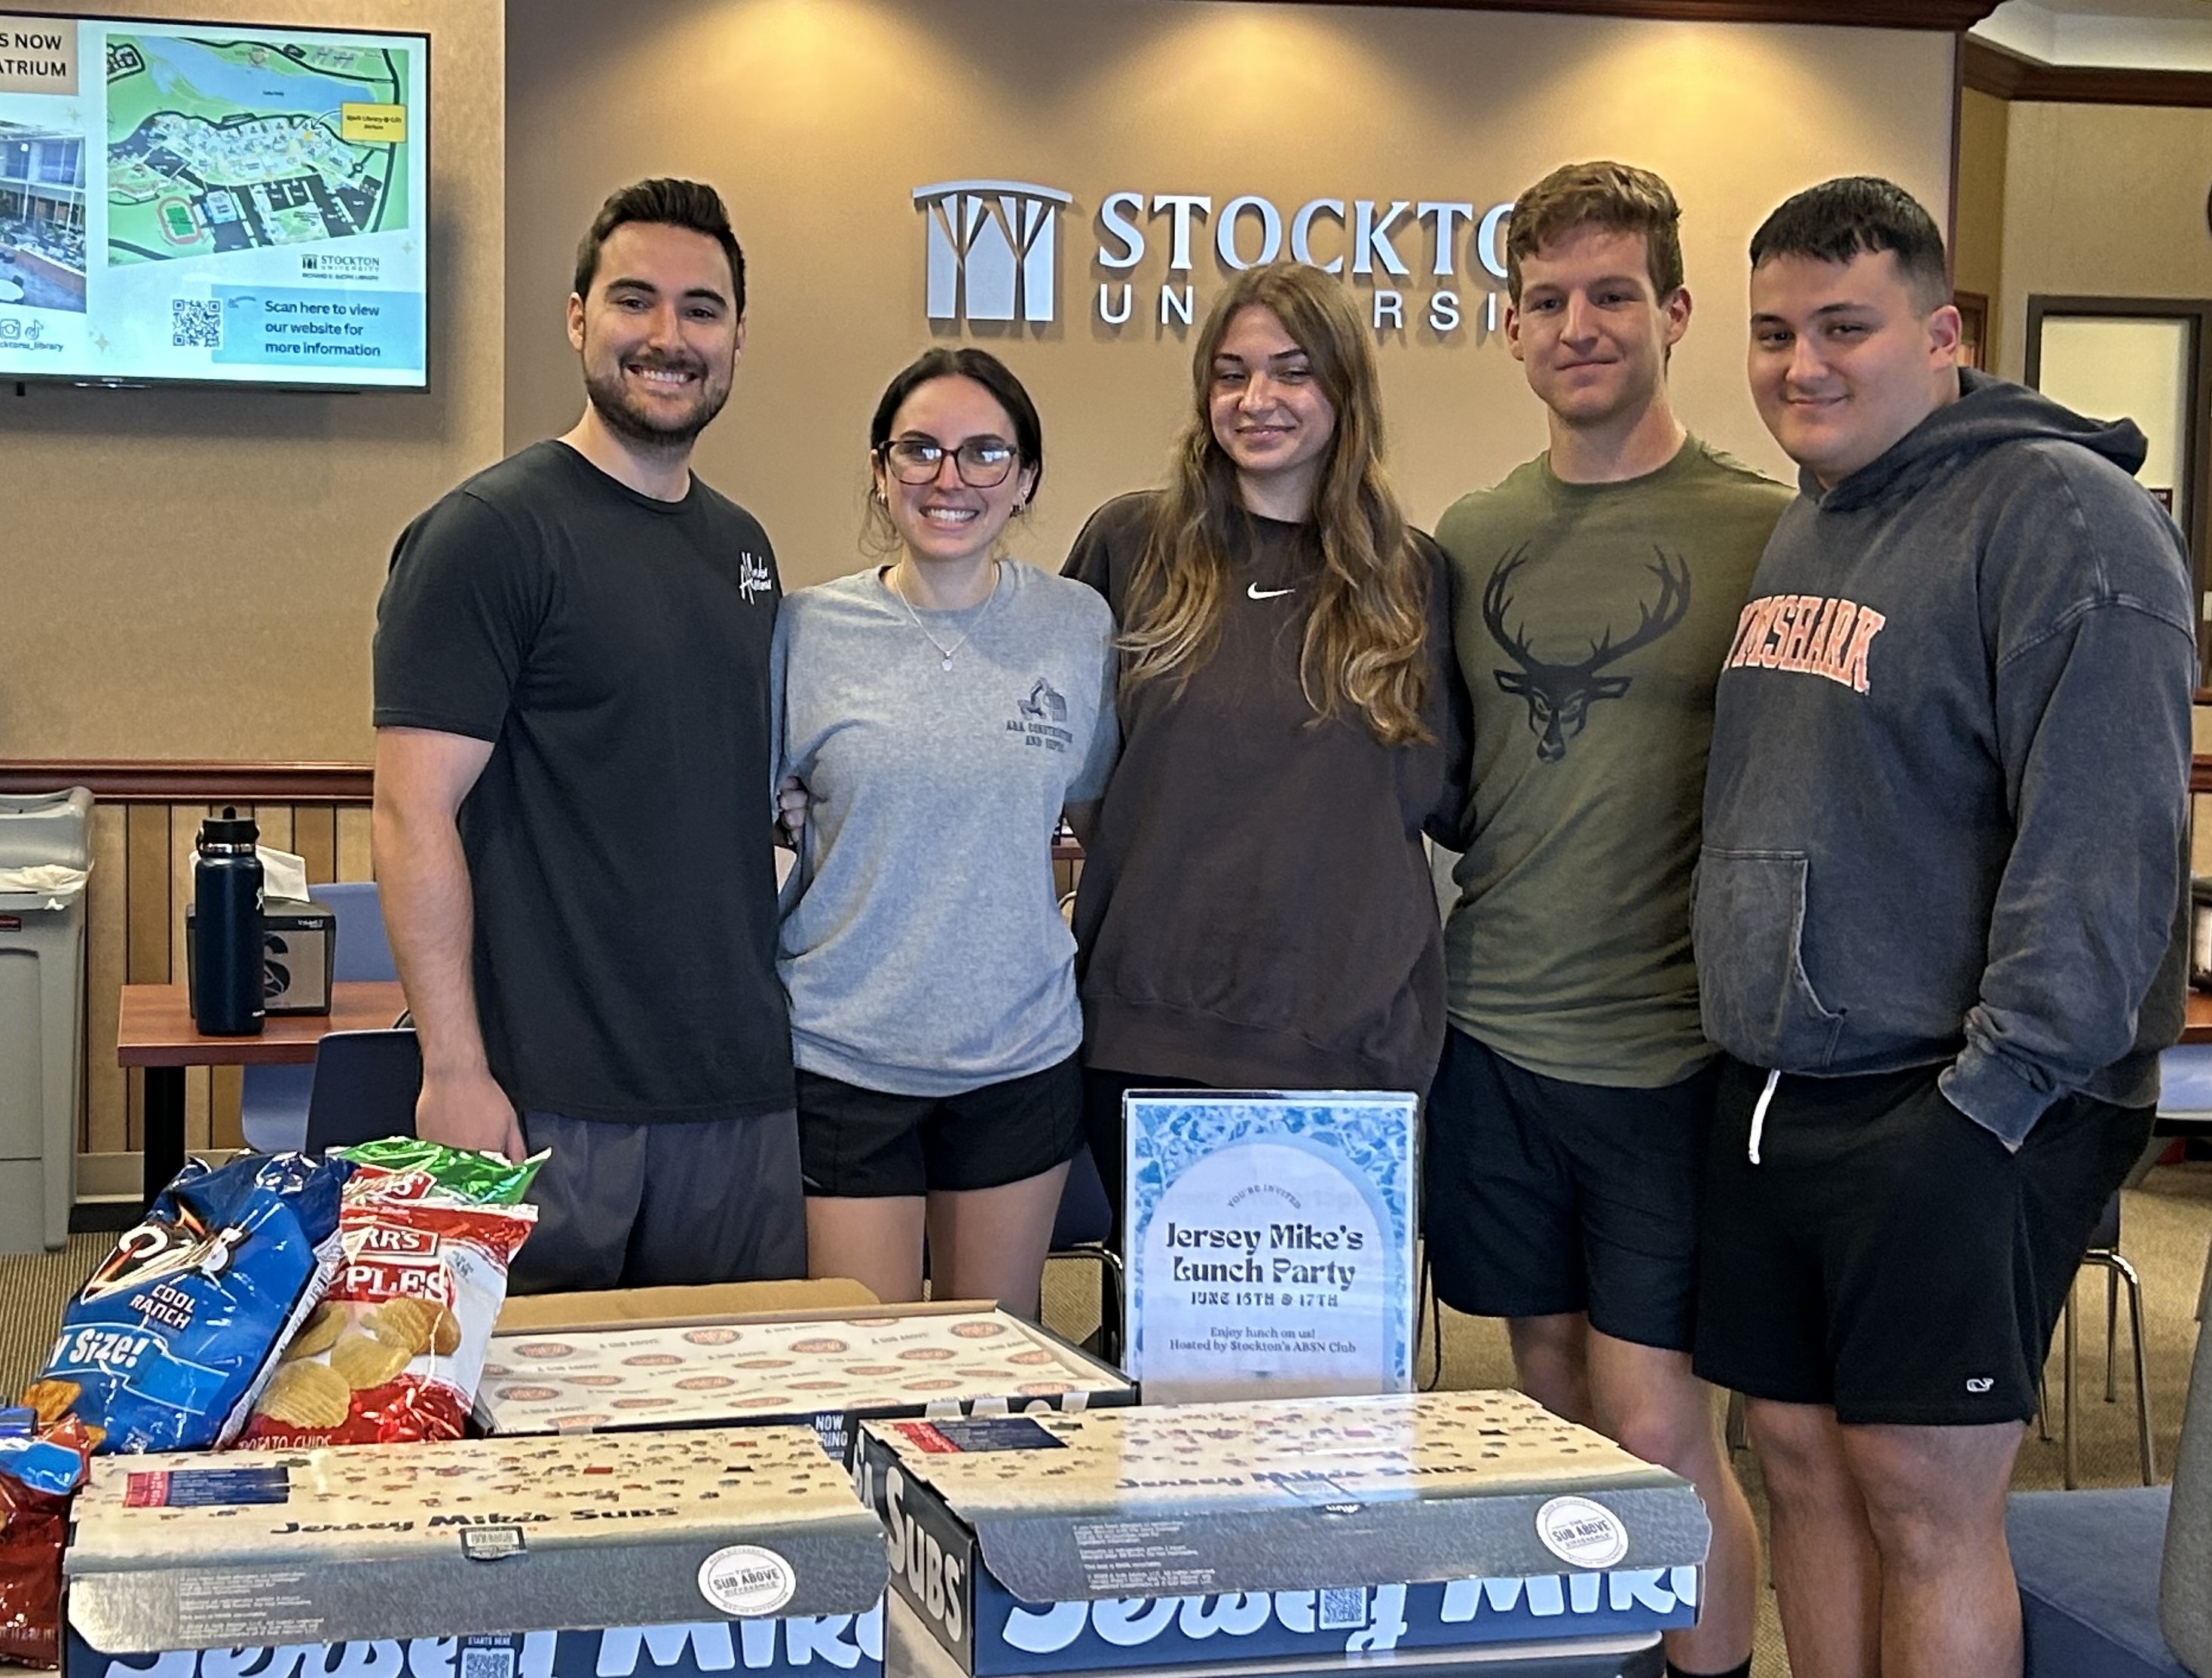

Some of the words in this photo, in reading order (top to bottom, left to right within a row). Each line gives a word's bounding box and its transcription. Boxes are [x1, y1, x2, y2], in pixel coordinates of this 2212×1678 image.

[15, 33, 62, 51] NOW
[1099, 191, 1516, 278] STOCKTO
[321, 255, 380, 267] STOCKTON
[265, 300, 298, 313] Scan
[301, 302, 330, 314] here
[332, 303, 347, 315] to
[350, 303, 380, 317] view
[1099, 283, 1497, 331] UNRSI
[265, 323, 289, 333] our
[290, 322, 341, 335] website
[344, 323, 364, 335] for
[265, 343, 301, 354] more
[303, 341, 381, 357] information
[1721, 595, 1886, 695] MSHARK
[366, 1227, 421, 1250] RR'S
[1166, 1222, 1261, 1256] Jersey
[1270, 1222, 1363, 1251] Mike's
[345, 1264, 447, 1303] PLES
[1173, 1255, 1263, 1283] Lunch
[1273, 1257, 1355, 1291] Party
[151, 1283, 196, 1313] COOL
[1192, 1291, 1230, 1306] JUNE
[1299, 1293, 1339, 1308] 17TH
[1210, 1327, 1243, 1340] Enjoy
[1245, 1327, 1278, 1338] lunch
[1281, 1330, 1296, 1338] on
[1298, 1328, 1315, 1339] us!
[69, 1327, 150, 1369] Size!
[1170, 1339, 1210, 1350] Hosted
[1213, 1340, 1228, 1353] by
[1230, 1340, 1290, 1352] Stockton's
[1293, 1341, 1326, 1352] ABSN
[1329, 1341, 1357, 1353] Club
[815, 1414, 844, 1431] NOW
[820, 1432, 849, 1447] RING
[1552, 1529, 1575, 1542] SUB
[1576, 1520, 1611, 1536] ABOVE
[713, 1576, 738, 1590] SUB
[742, 1568, 780, 1585] ABOVE
